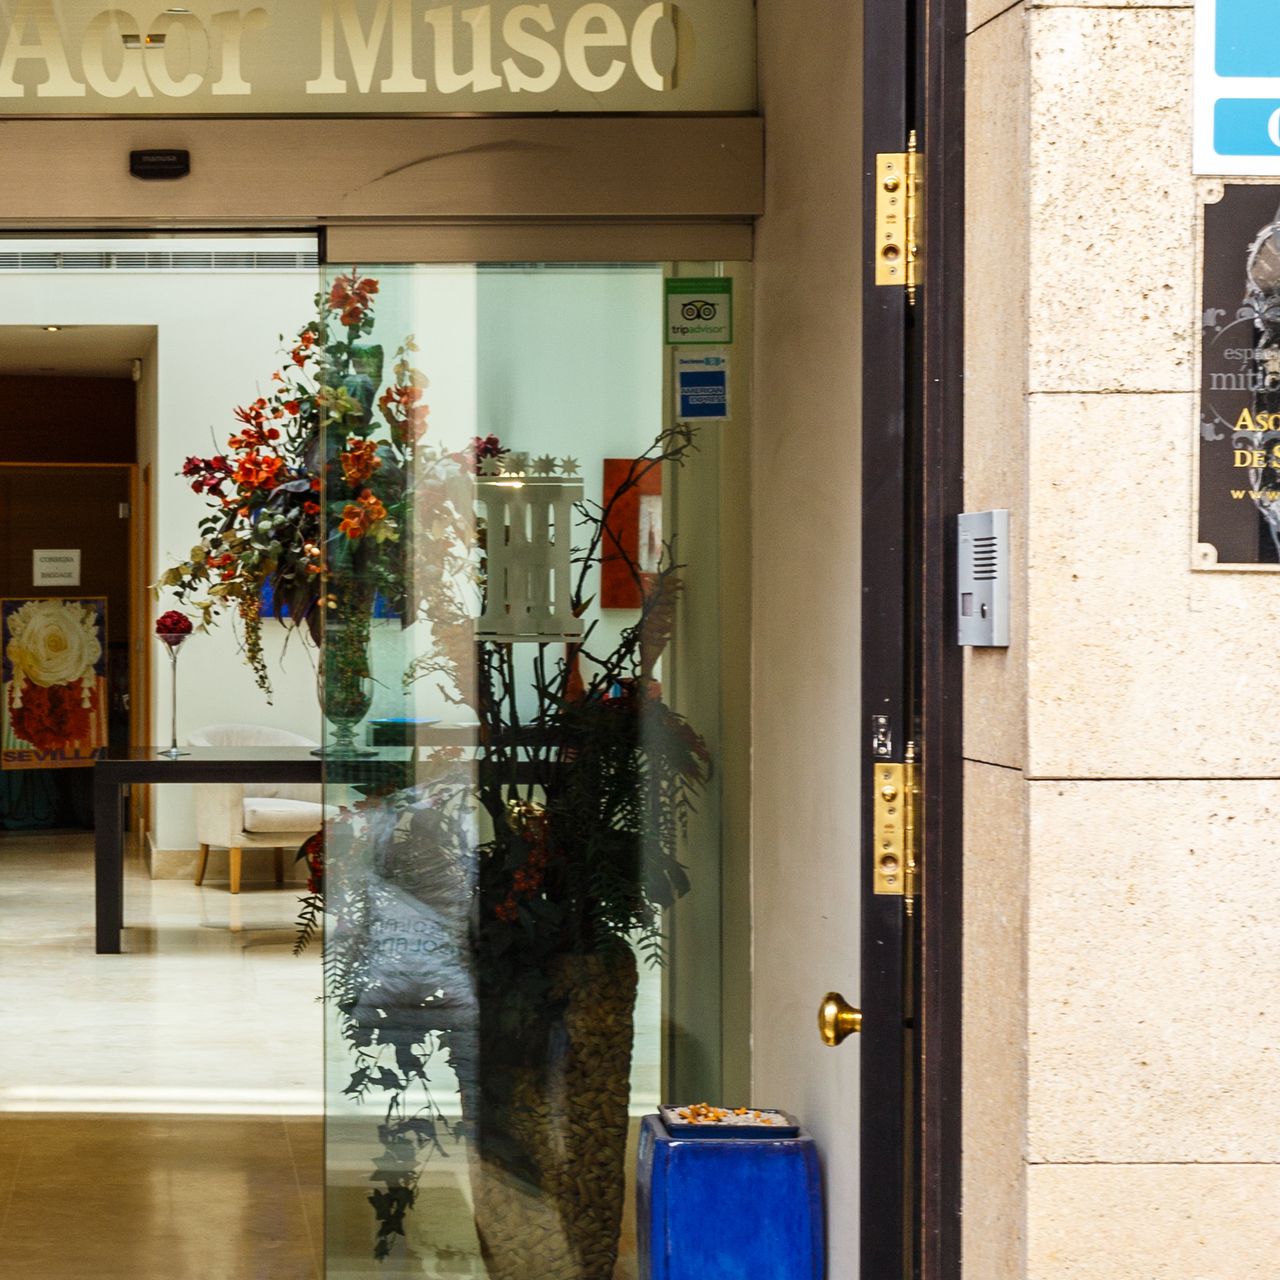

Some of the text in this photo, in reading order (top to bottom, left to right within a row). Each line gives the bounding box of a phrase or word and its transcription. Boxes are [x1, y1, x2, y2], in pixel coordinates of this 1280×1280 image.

[671, 324, 727, 337] tripadvisor
[680, 385, 725, 396] AMERICAN
[1233, 449, 1268, 468] DE
